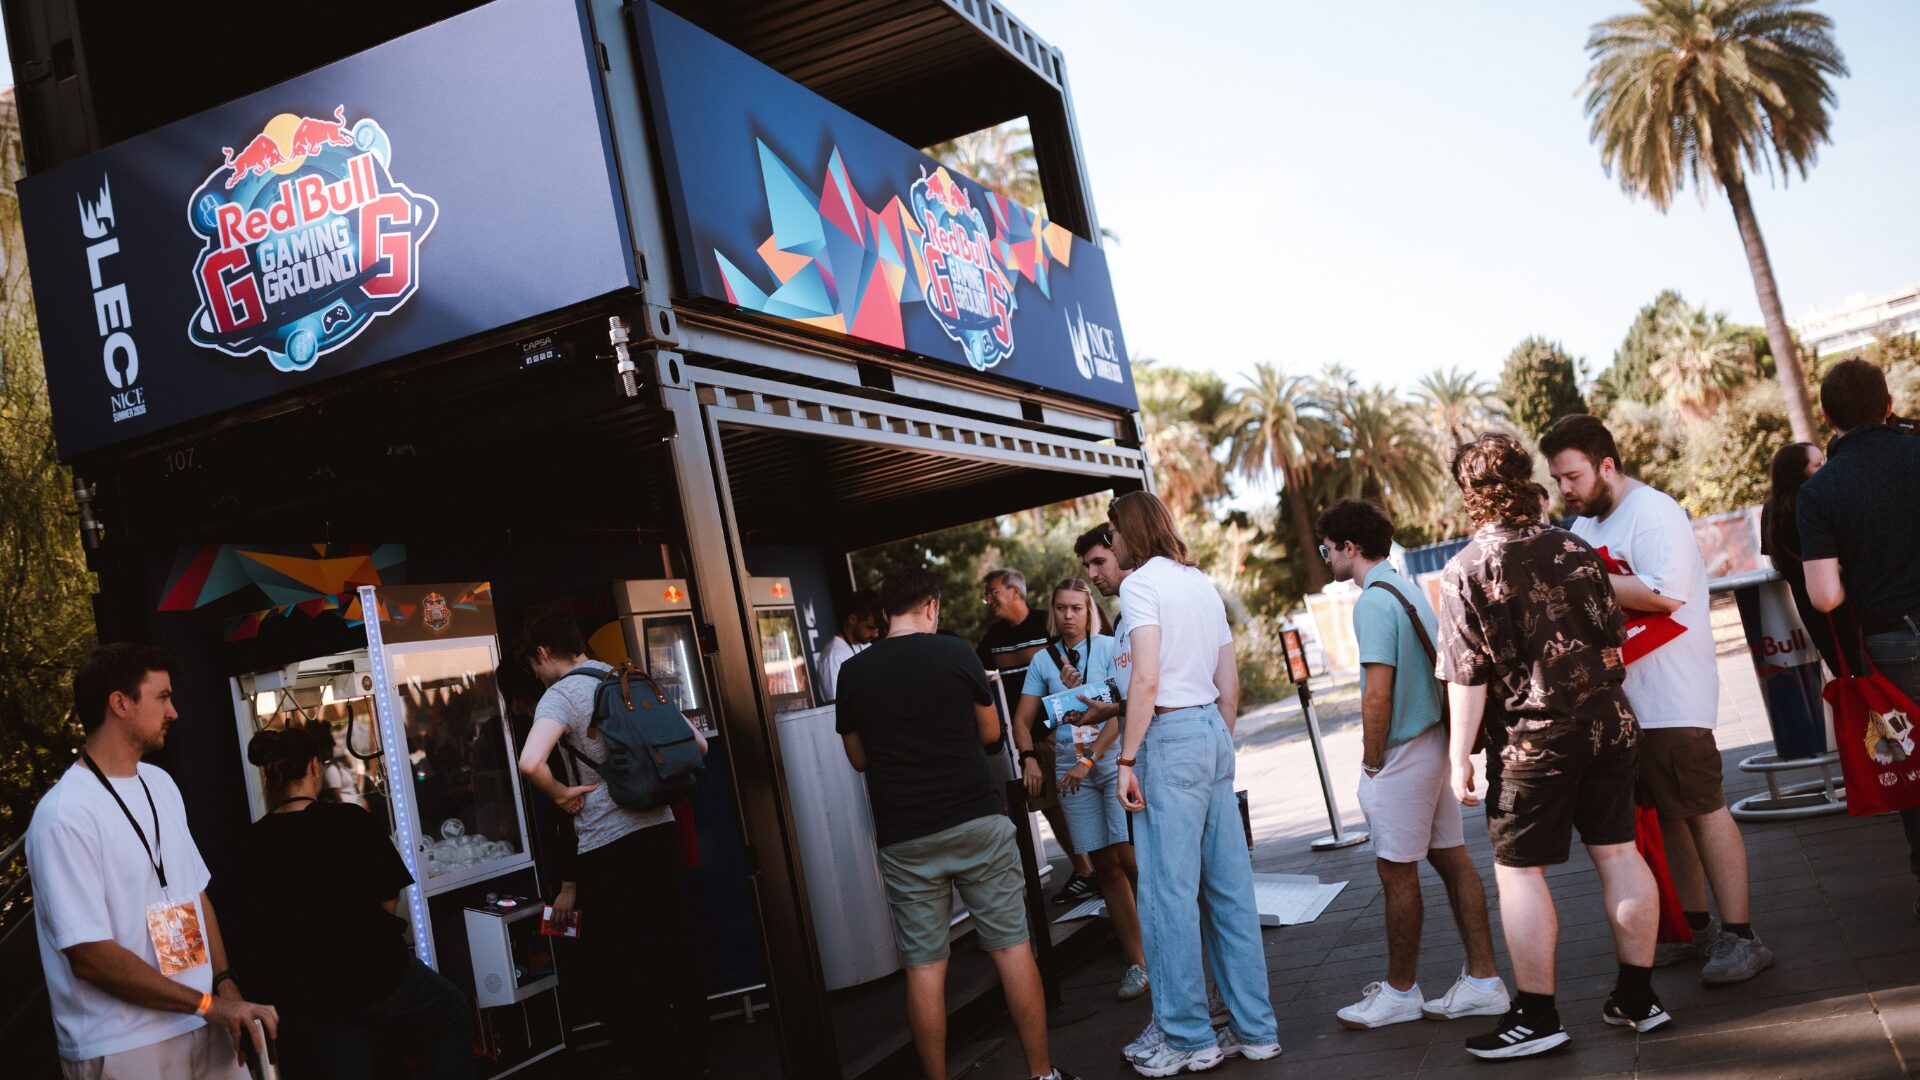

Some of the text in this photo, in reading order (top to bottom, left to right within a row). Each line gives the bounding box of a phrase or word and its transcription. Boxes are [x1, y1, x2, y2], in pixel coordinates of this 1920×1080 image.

[217, 154, 378, 250] Red Bull
[259, 218, 351, 274] GAMING
[925, 209, 990, 270] Red Bull
[201, 247, 267, 334] G
[262, 247, 358, 304] GROUND
[948, 257, 984, 294] GAMING
[86, 236, 139, 389] LEC
[952, 281, 992, 318] GROUND
[522, 336, 552, 352] CAPSA
[1086, 321, 1120, 362] NICE
[111, 387, 145, 412] NICE
[166, 448, 194, 472] 107
[1761, 628, 1807, 658] Bull
